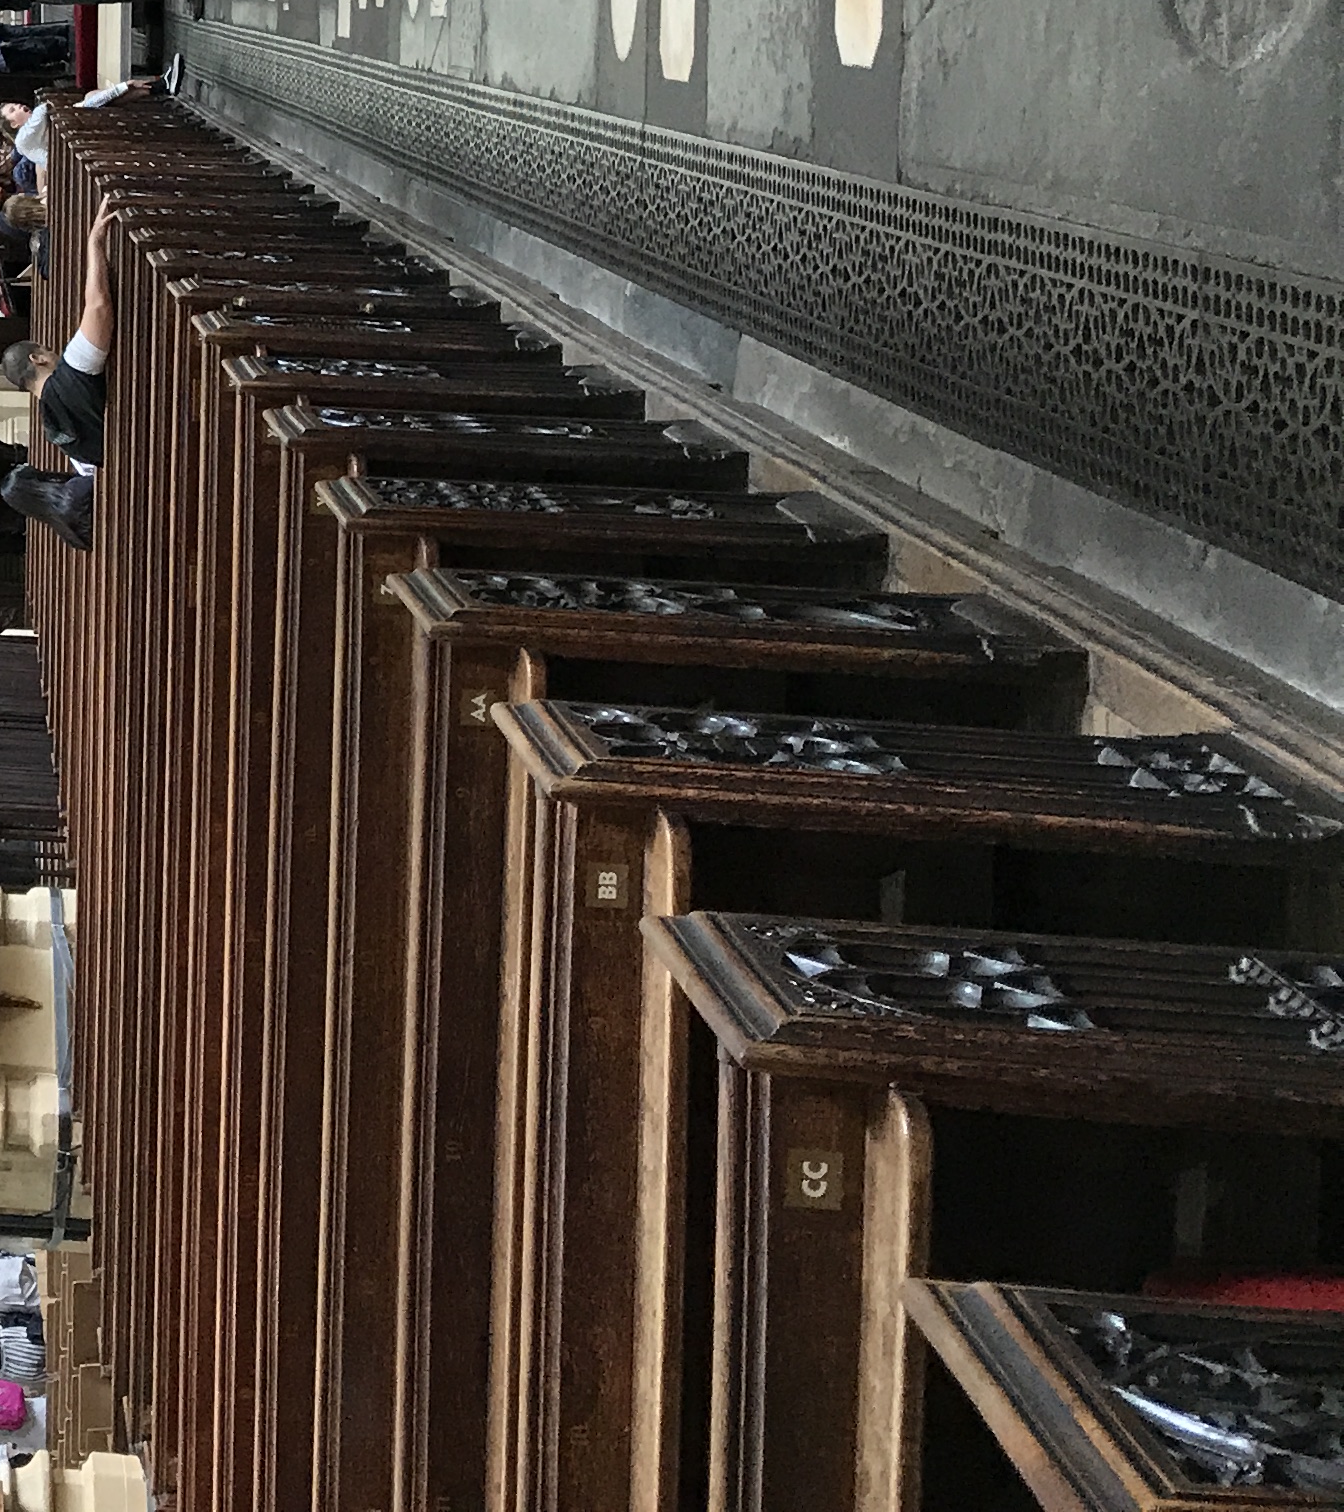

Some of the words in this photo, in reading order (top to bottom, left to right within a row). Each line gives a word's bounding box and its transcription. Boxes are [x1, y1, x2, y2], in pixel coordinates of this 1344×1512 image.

[469, 694, 488, 722] AA
[597, 870, 618, 900] BB
[802, 1160, 829, 1199] CC
